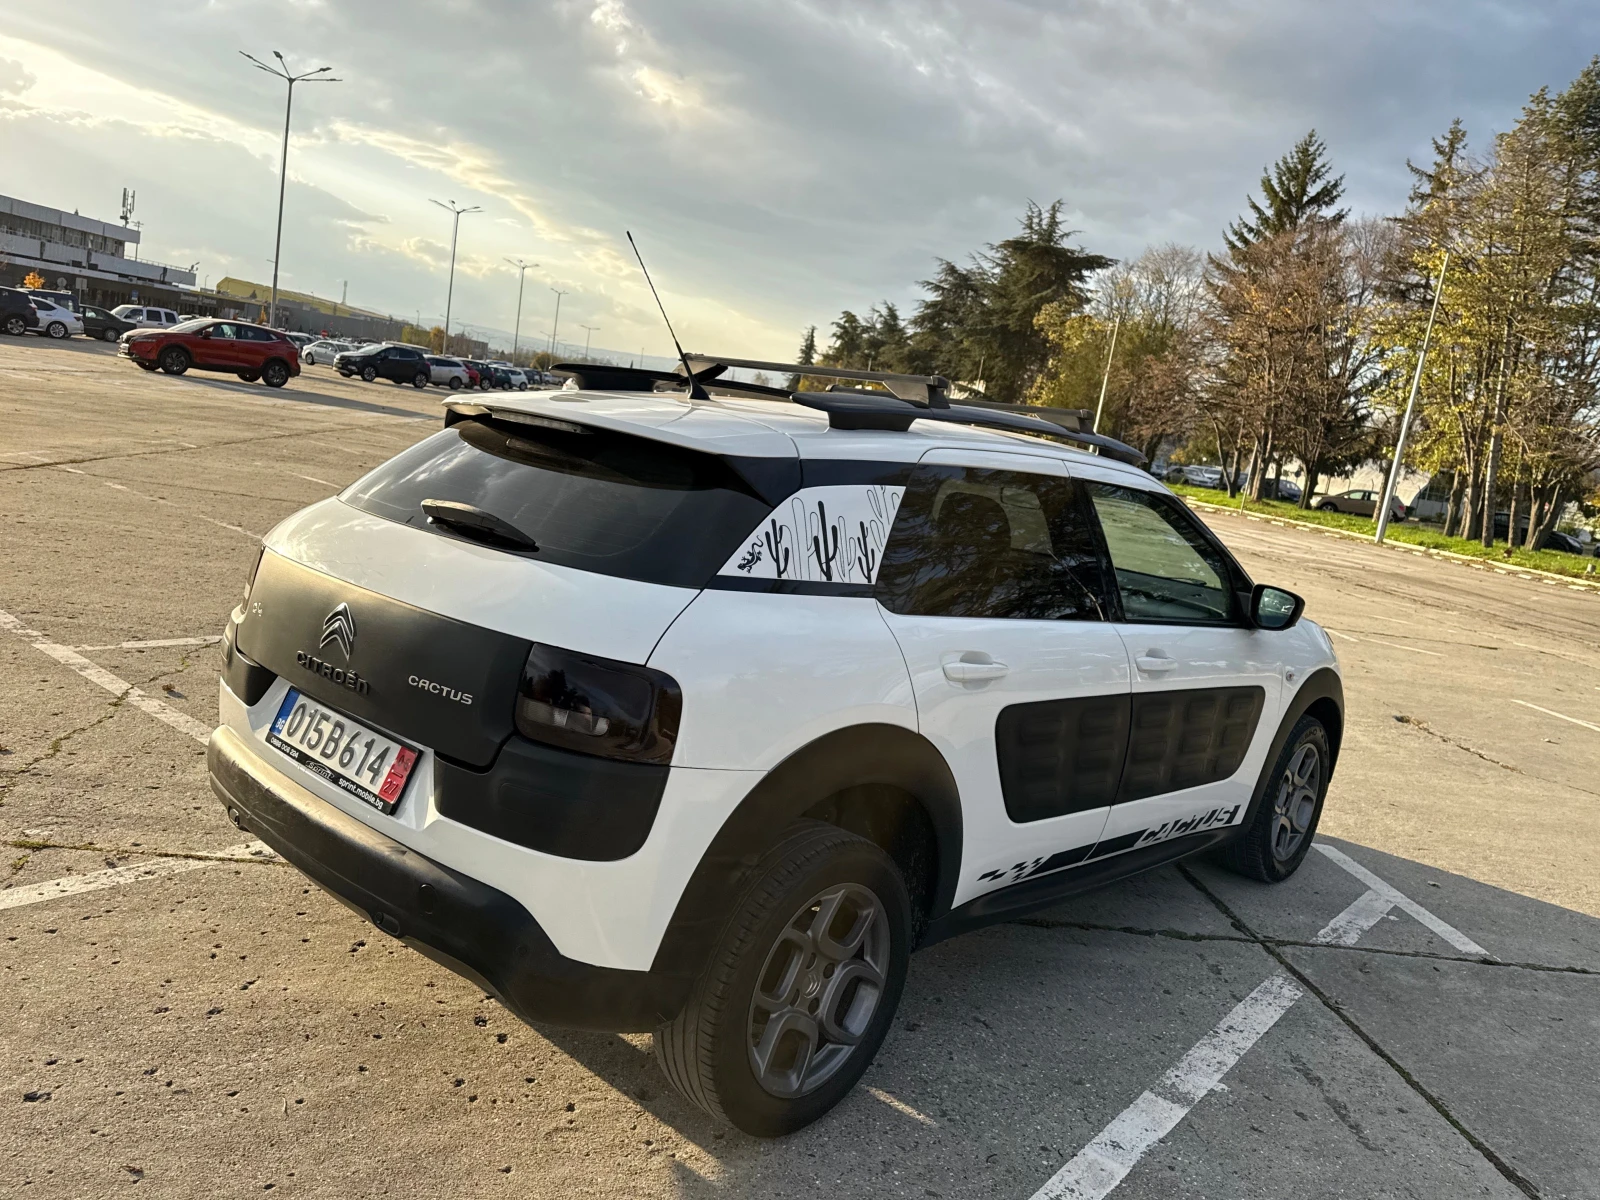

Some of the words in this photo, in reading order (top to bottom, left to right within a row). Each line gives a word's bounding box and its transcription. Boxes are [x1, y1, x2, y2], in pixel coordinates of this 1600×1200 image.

[408, 675, 473, 706] CACTUS
[286, 701, 391, 786] 015B614
[338, 777, 384, 810] sprint.mobile.bg
[383, 778, 399, 795] 27
